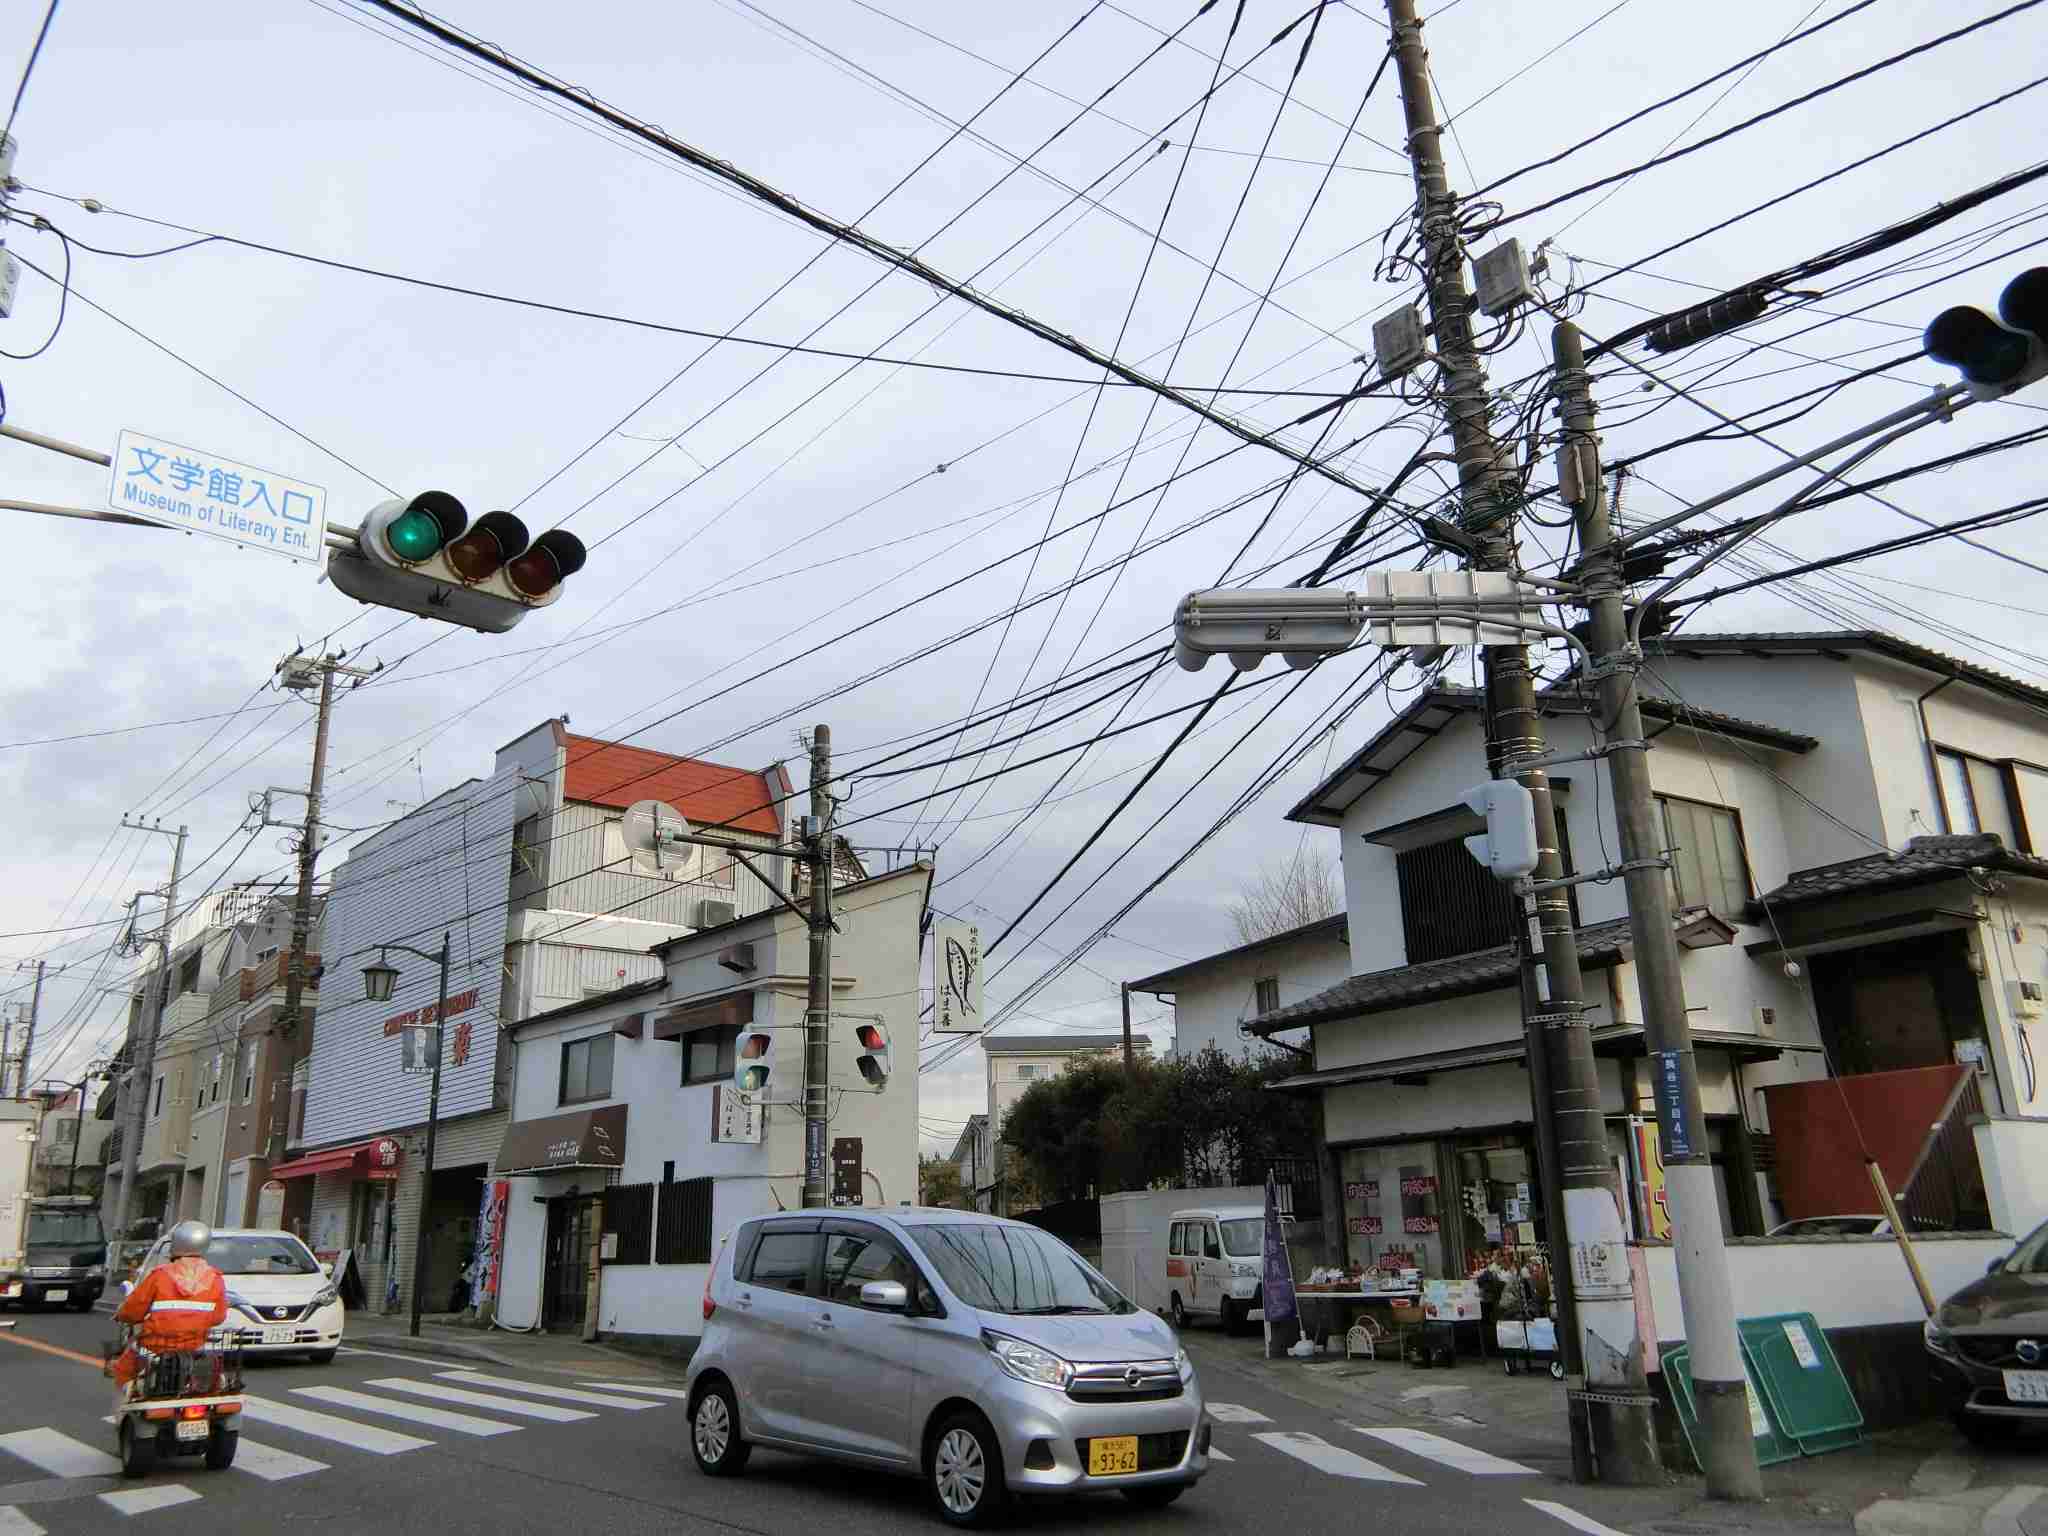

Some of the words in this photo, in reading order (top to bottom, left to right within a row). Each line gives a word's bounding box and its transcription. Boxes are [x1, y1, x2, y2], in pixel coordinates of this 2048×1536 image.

[124, 482, 191, 518] Museum
[197, 505, 213, 522] of
[219, 509, 277, 543] Literary
[283, 528, 310, 549] Ent.
[127, 447, 313, 524] 文学館入口
